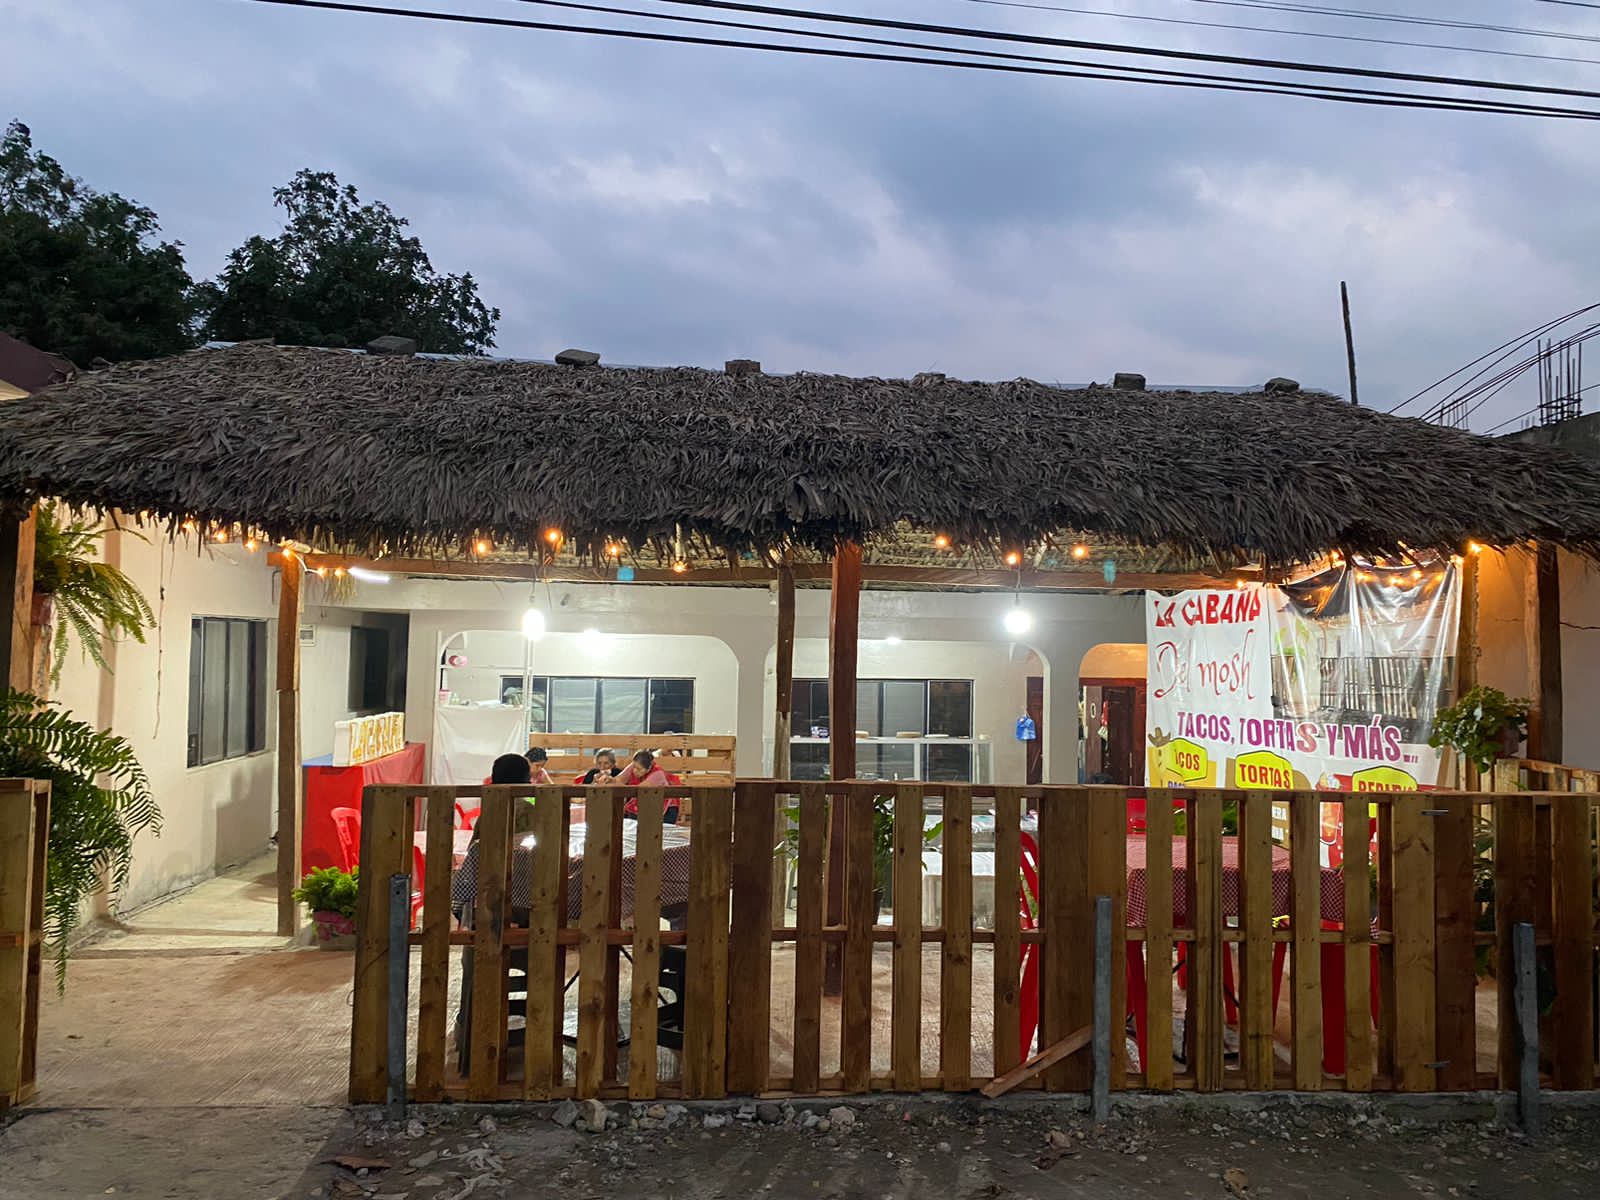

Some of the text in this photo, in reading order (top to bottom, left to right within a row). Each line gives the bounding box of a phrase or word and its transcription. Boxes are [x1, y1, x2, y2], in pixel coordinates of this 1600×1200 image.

[1154, 600, 1176, 627] LA
[1177, 712, 1235, 744] TACOS,
[1239, 718, 1316, 753] TORTAS
[1325, 724, 1337, 755] Y
[1239, 763, 1290, 789] TORTAS
